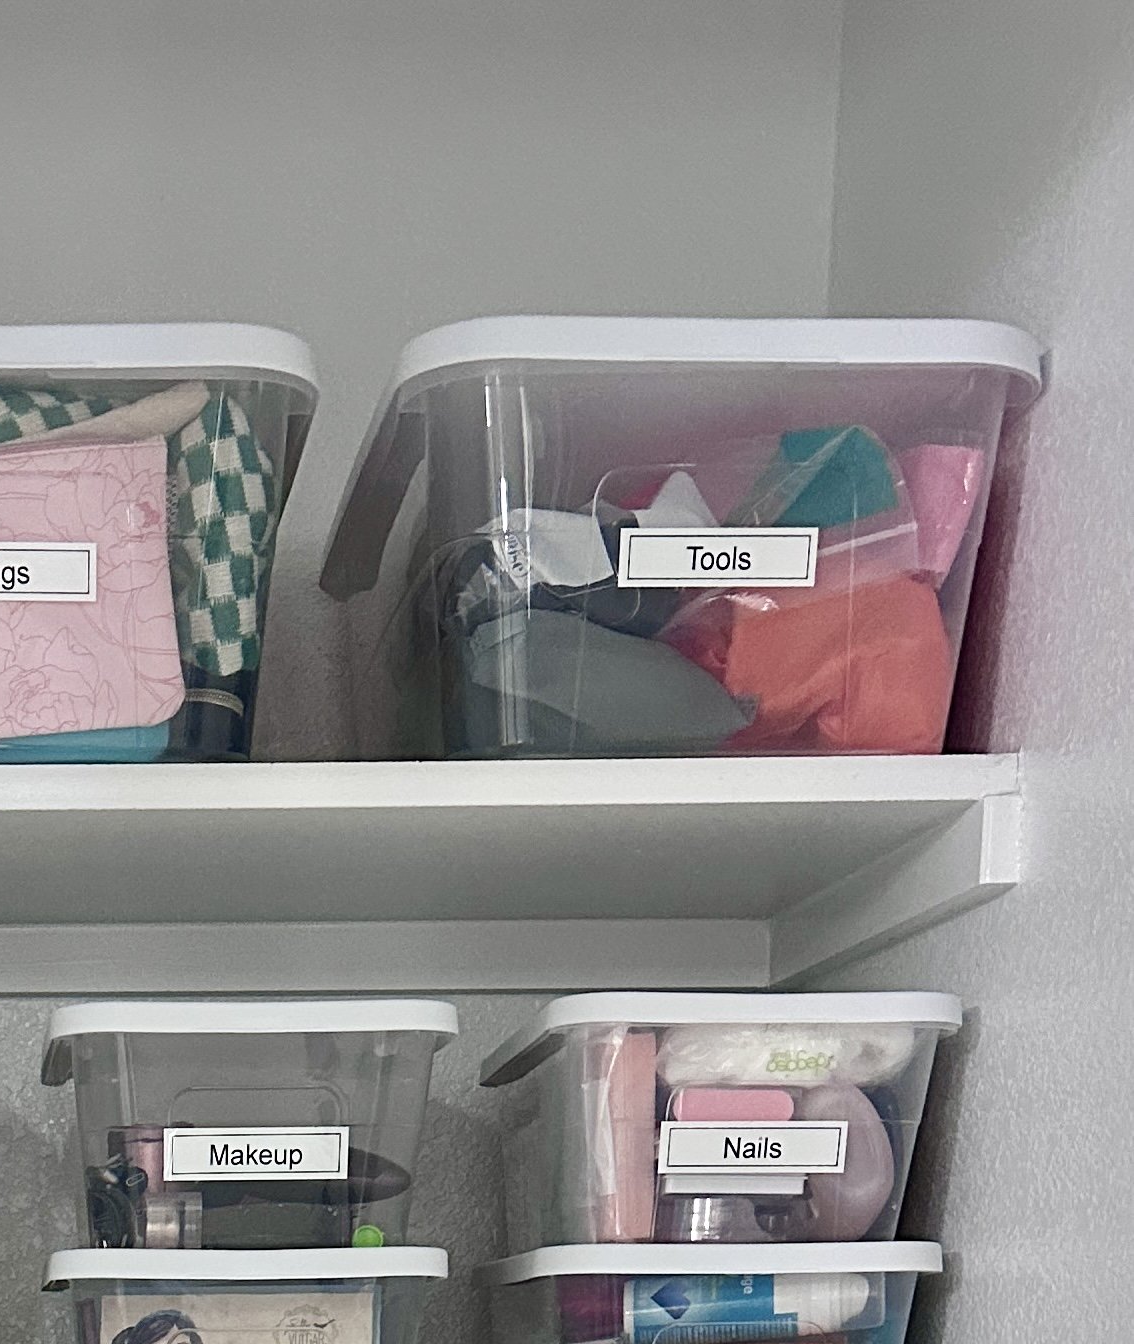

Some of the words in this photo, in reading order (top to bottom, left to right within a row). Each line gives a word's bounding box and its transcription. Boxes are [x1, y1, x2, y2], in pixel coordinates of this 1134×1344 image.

[687, 546, 751, 570] Tools
[210, 1144, 302, 1170] Makeup
[724, 1137, 781, 1158] Nails
